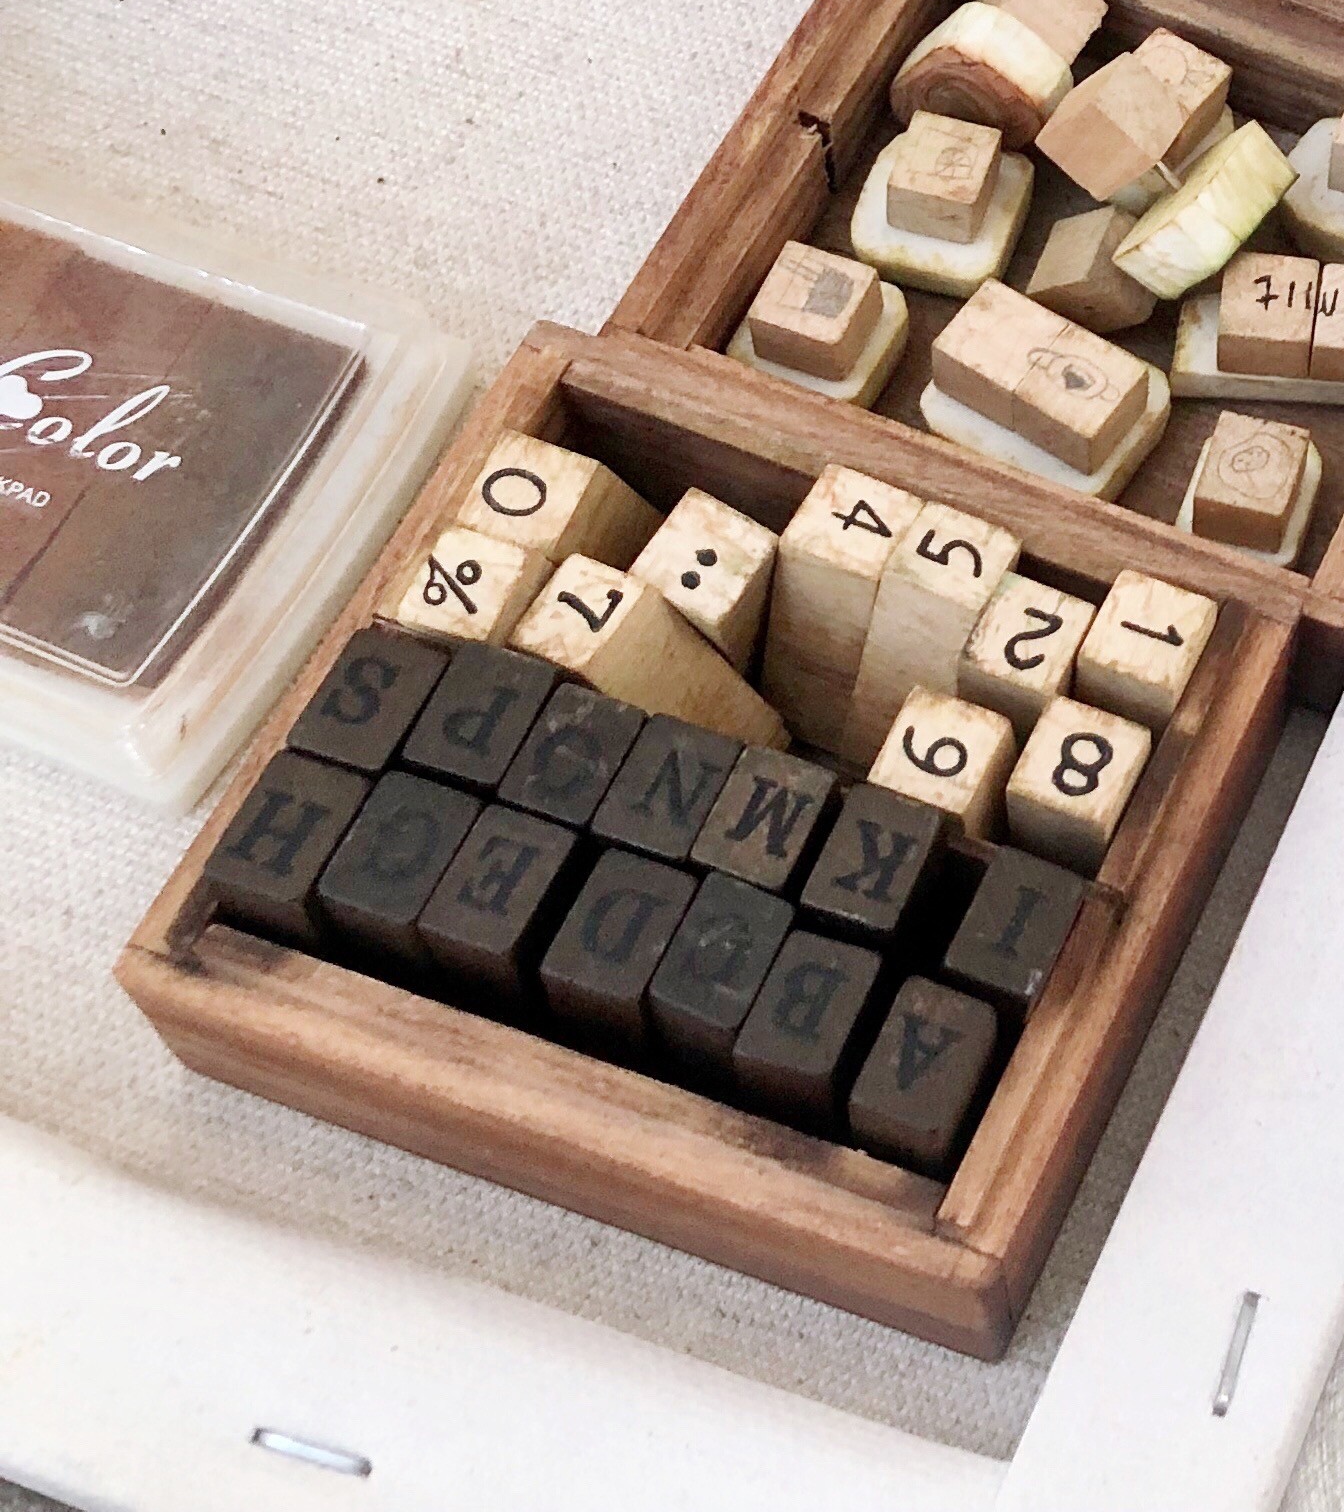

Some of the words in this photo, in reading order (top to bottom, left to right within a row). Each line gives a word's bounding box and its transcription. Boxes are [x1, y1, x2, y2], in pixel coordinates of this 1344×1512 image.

[0, 475, 51, 508] KPAD
[832, 500, 892, 538] 4
[916, 529, 982, 577] 5
[557, 589, 623, 632] 7
[1004, 607, 1063, 670] 2
[1121, 620, 1184, 646] 1
[318, 655, 400, 725] S
[442, 684, 519, 757] P
[631, 750, 725, 829] N
[1052, 732, 1113, 796] 8
[224, 790, 330, 878] H
[725, 774, 815, 858] M
[458, 835, 540, 917] E
[830, 819, 919, 901] K
[579, 890, 666, 964] D
[989, 885, 1042, 959] I
[771, 961, 848, 1042] B
[902, 1014, 965, 1082] A
